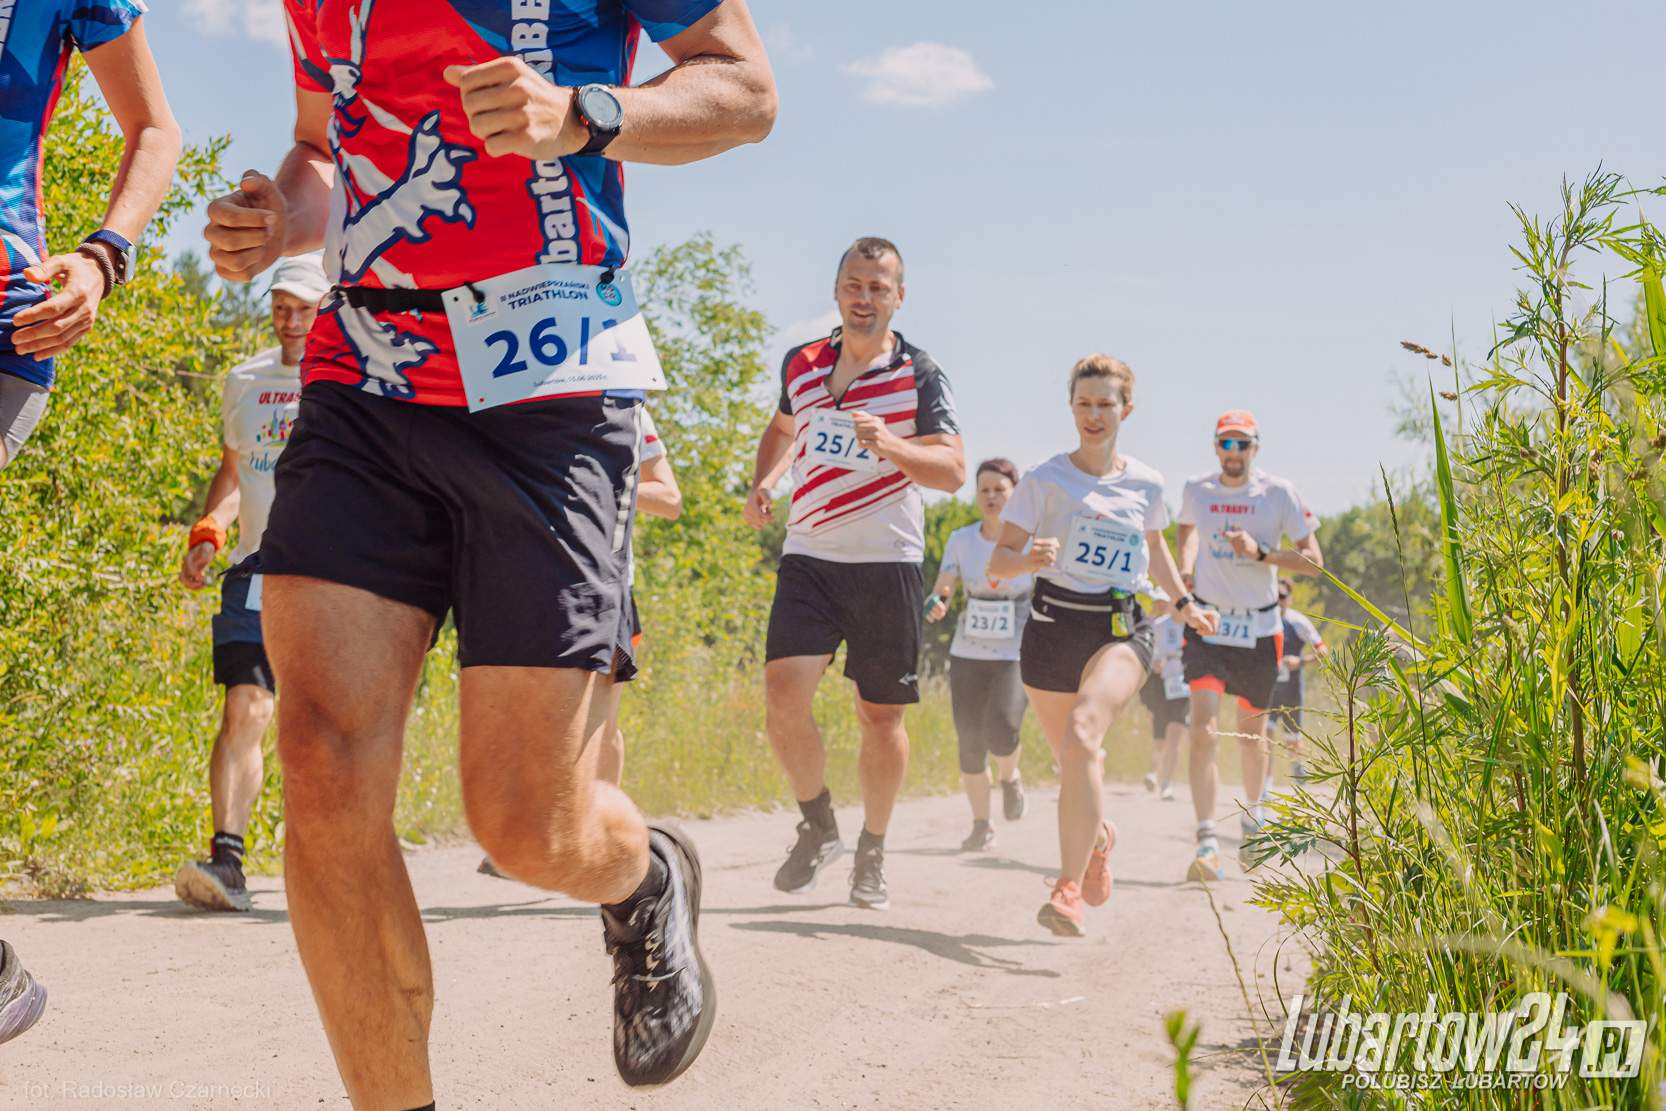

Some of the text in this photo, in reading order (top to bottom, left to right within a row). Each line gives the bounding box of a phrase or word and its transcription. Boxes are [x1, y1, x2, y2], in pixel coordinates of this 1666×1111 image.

[508, 289, 588, 310] TRIATHLON
[484, 317, 638, 379] 26/1
[1074, 542, 1131, 573] 25/1
[971, 615, 1008, 631] 23/2
[1217, 622, 1249, 638] 3/1
